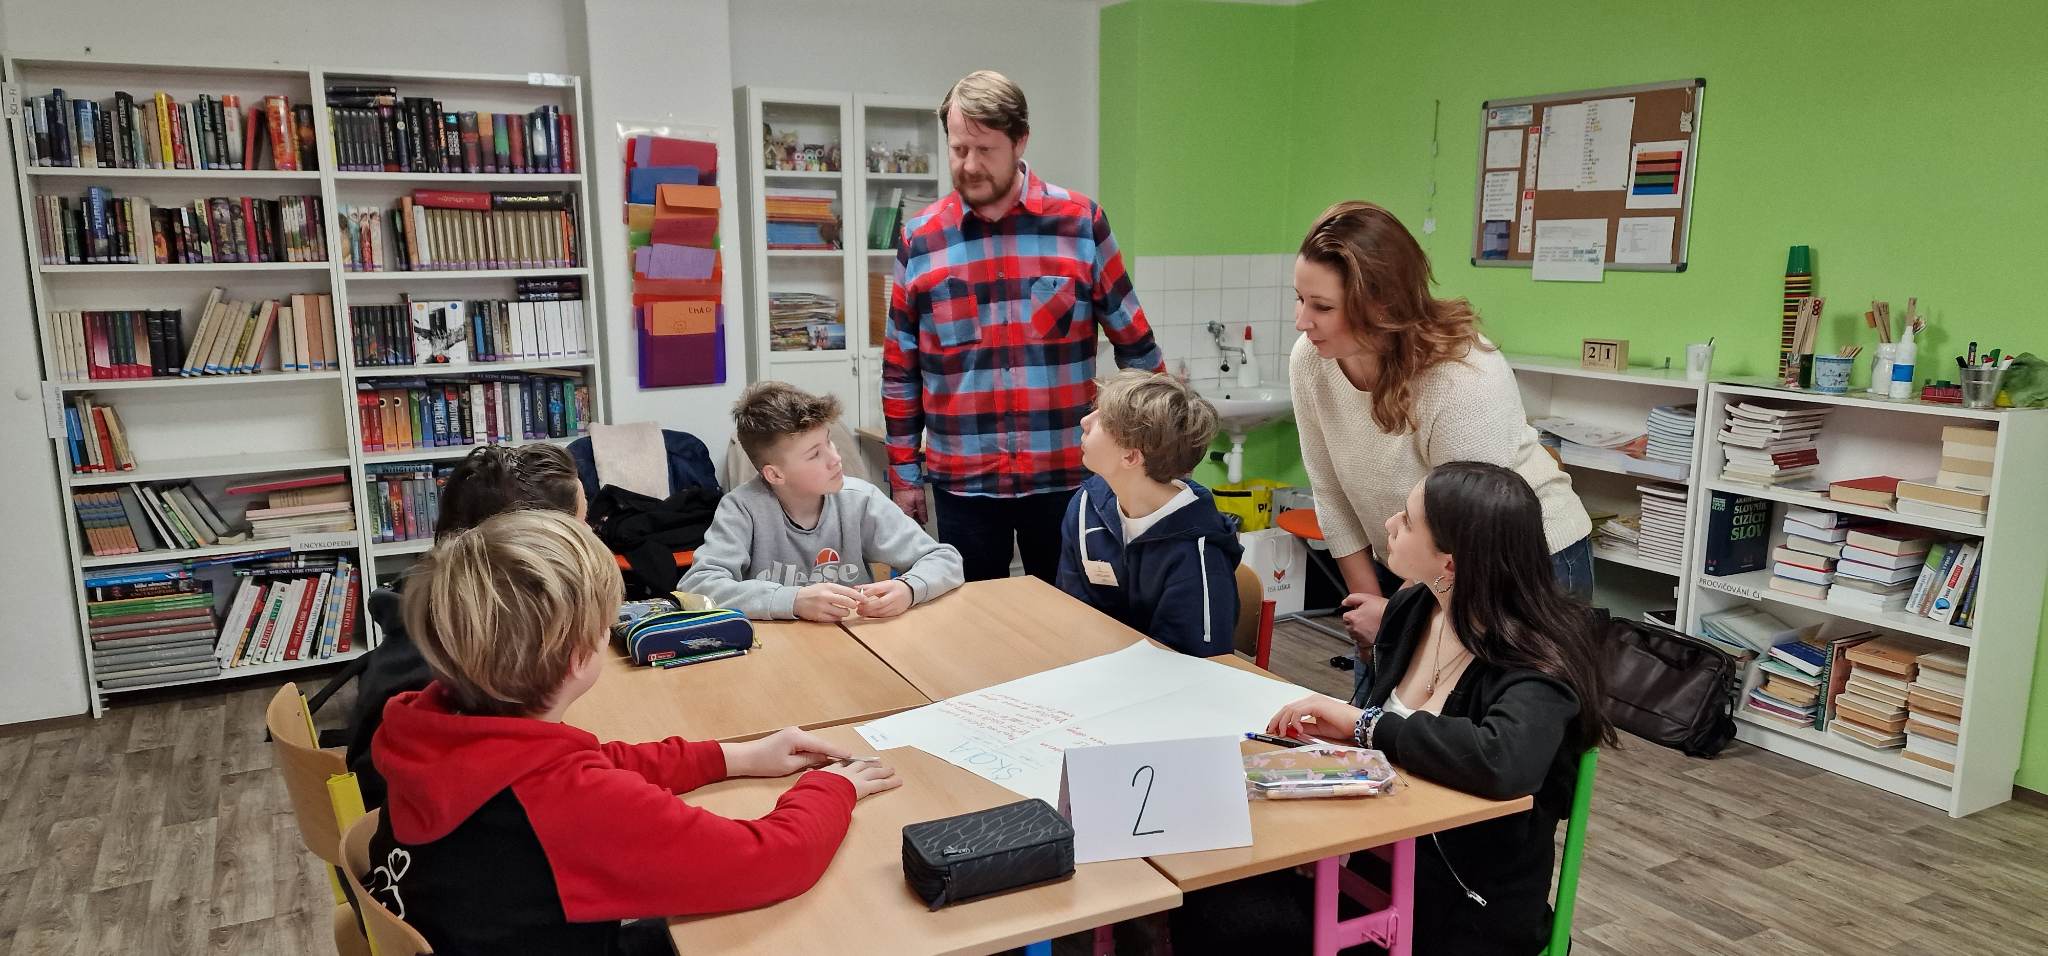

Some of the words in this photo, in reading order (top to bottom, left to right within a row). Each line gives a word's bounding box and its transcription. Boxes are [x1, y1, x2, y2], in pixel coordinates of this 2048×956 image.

[118, 98, 128, 128] ARTEMIS
[91, 187, 103, 229] TURNUS
[1732, 510, 1766, 526] CIZÍCH
[1733, 501, 1767, 515] SLOVNÍK
[1730, 523, 1766, 543] SLOV
[299, 539, 353, 550] ENCYKLOPEDIE
[1698, 578, 1751, 597] PROCVIČOVÁNÍ
[296, 610, 307, 641] LAROUSSE
[1131, 765, 1165, 837] 2
